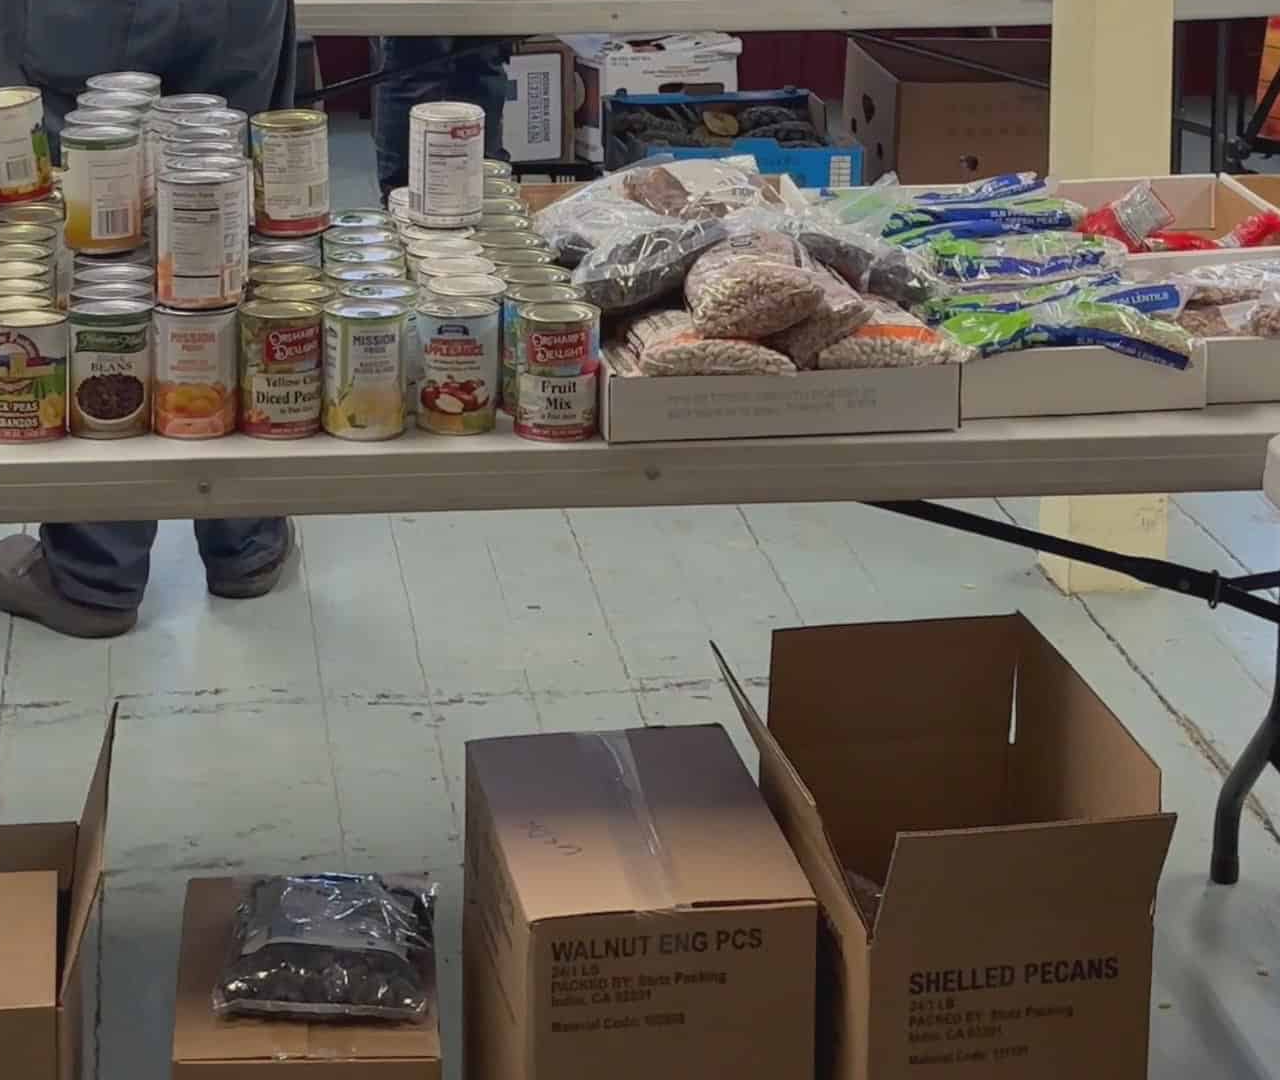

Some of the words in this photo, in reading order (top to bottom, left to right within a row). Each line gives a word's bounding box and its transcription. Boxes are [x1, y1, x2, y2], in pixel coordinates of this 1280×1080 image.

[352, 334, 396, 346] MISSION
[266, 376, 301, 388] Yellow
[541, 380, 577, 394] Fruit
[256, 391, 290, 405] Diced
[544, 397, 572, 410] Mix
[551, 936, 651, 961] WALNUT
[658, 931, 708, 954] ENG
[715, 928, 763, 951] PCS
[908, 965, 1015, 995] SHELLED
[1023, 956, 1120, 985] PECANS
[551, 977, 608, 993] PACKED
[591, 991, 611, 1005] CA
